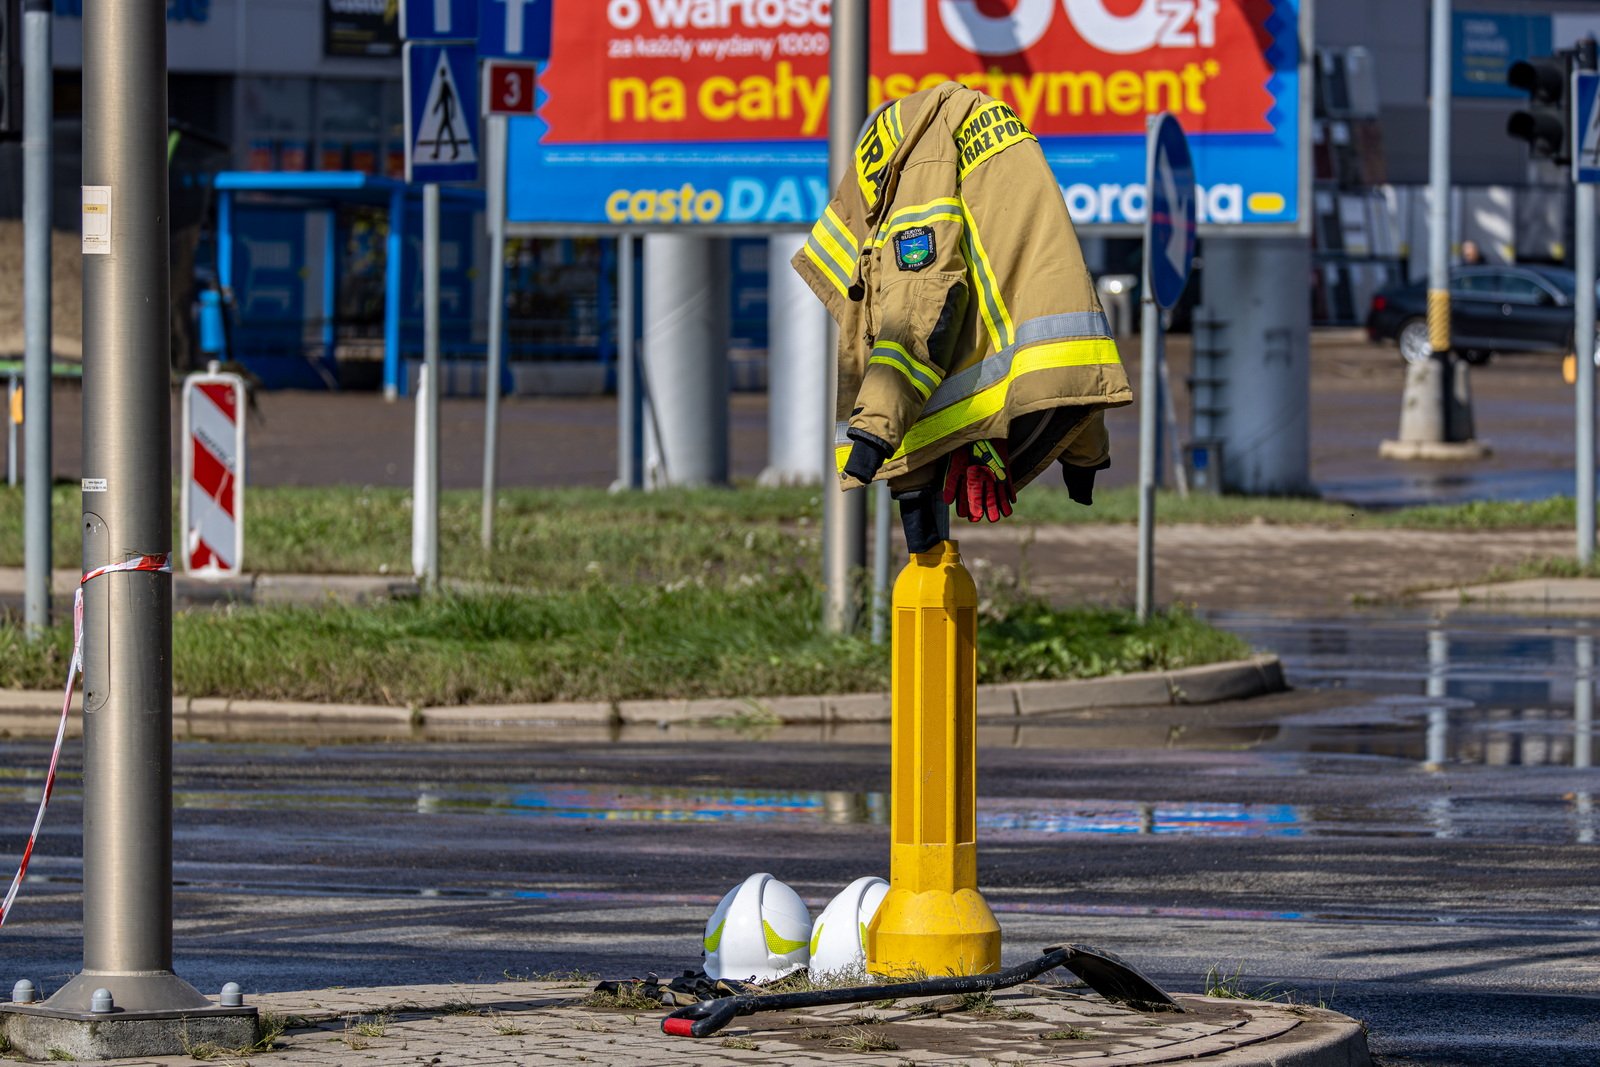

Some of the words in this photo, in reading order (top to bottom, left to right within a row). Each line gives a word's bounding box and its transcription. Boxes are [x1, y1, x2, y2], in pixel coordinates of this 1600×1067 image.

[607, 0, 642, 30] o
[503, 71, 522, 107] 3
[608, 77, 686, 121] na
[698, 61, 830, 135] cały
